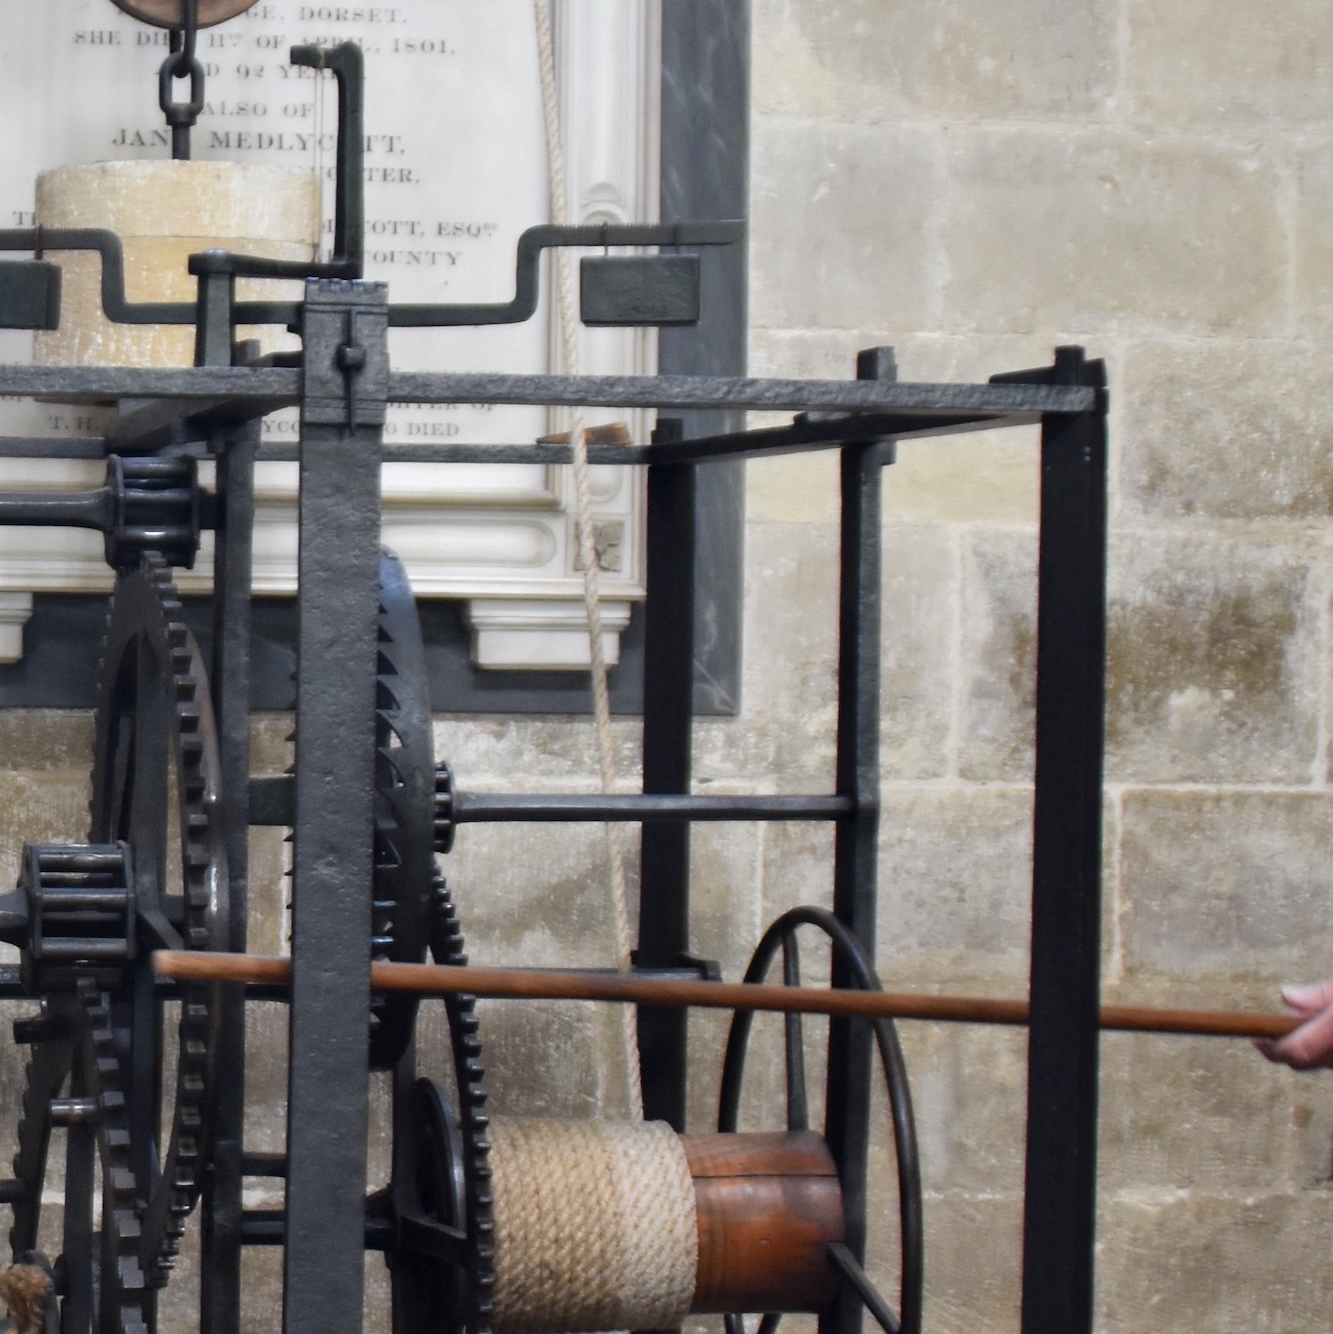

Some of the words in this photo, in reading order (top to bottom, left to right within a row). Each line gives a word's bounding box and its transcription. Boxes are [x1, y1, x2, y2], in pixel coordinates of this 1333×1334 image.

[74, 30, 121, 45] SHE
[256, 34, 285, 48] OF
[236, 63, 265, 79] 92
[201, 100, 268, 117] ALSO
[282, 101, 316, 117] OF
[407, 422, 460, 437] DIED
